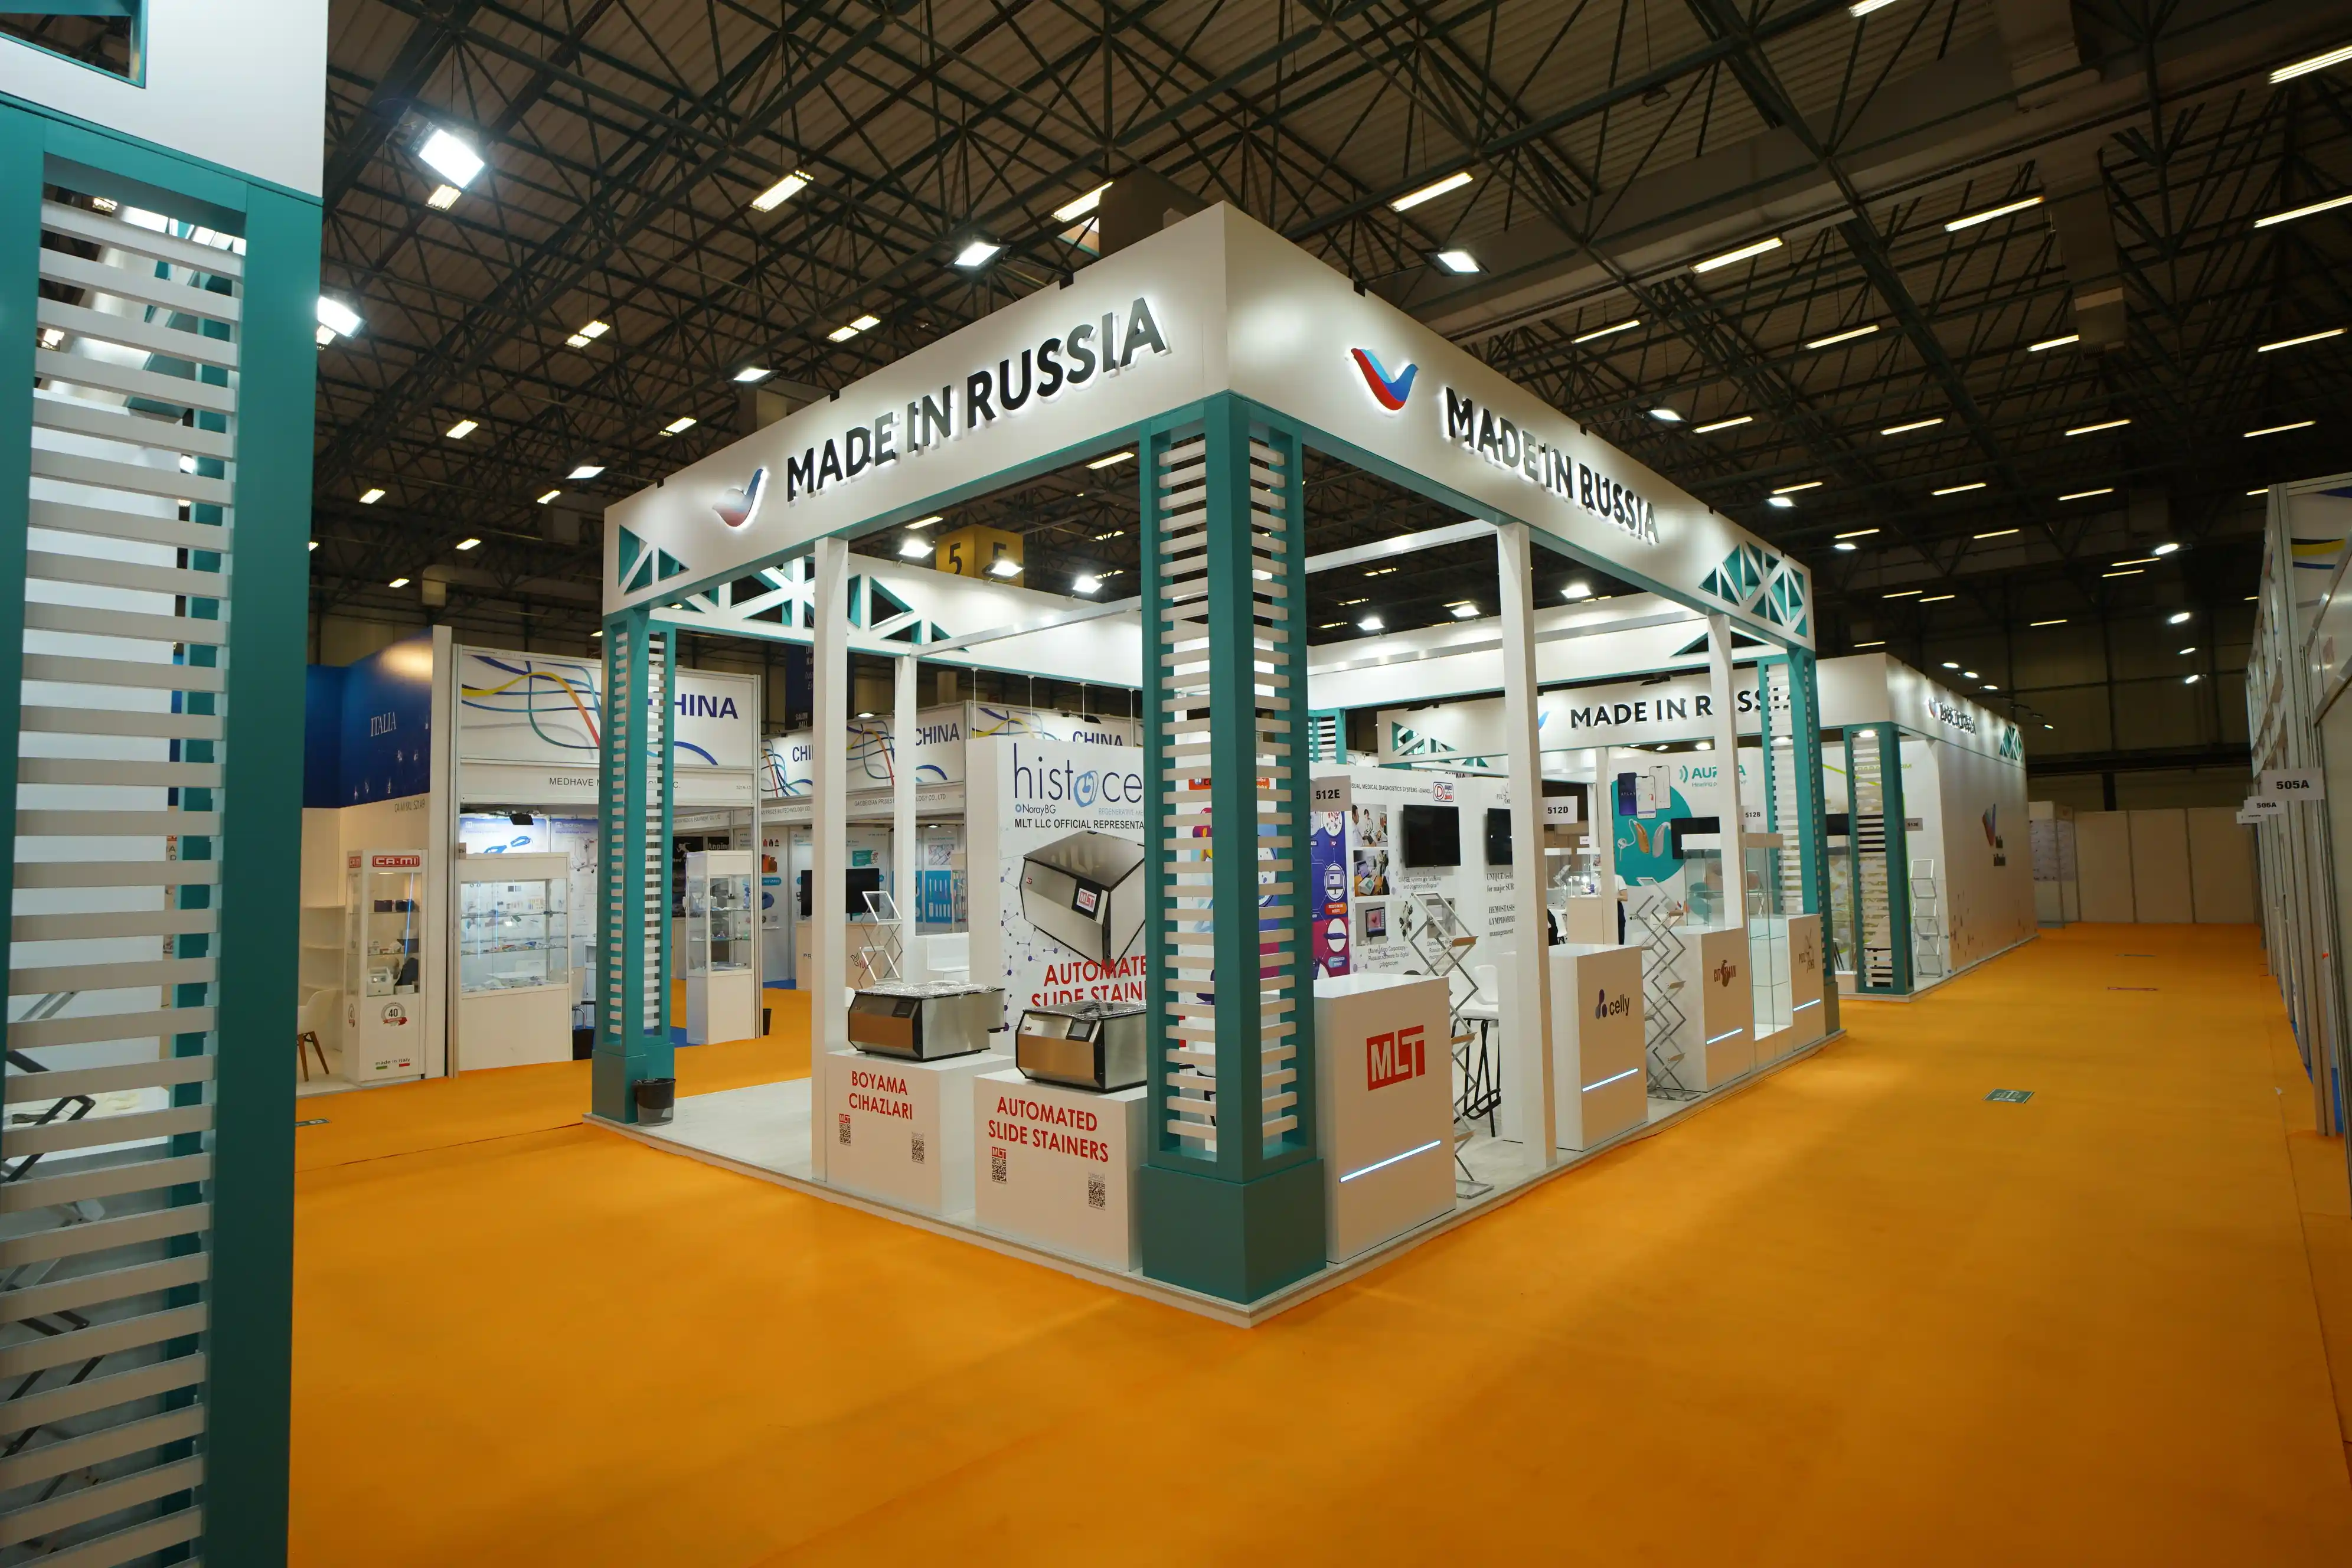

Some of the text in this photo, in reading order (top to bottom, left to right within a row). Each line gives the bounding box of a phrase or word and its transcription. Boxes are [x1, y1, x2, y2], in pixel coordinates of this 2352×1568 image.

[787, 297, 1165, 502] MADE IN RUSSIA
[1446, 387, 1660, 544] MADE IN RUSSIA
[949, 542, 962, 575] 5
[648, 691, 739, 720] HINA
[1570, 701, 1648, 729] MADE
[1657, 697, 1687, 720] IN
[371, 711, 397, 737] ITALIA
[916, 723, 960, 746] CHINA
[549, 778, 594, 786] MEDHAVE
[2276, 780, 2309, 789] 505A
[1315, 789, 1340, 800] 512E
[1023, 803, 1056, 816] NorayBG
[1547, 805, 1568, 814] 512D
[1015, 819, 1144, 829] MLT LLC OFFICIAL REPRESENTA
[1487, 873, 1504, 881] UNIQUE
[1494, 884, 1505, 893] major
[1079, 890, 1096, 908] MLT
[1044, 955, 1146, 986] AUTOMATE
[388, 1008, 398, 1017] 40
[1609, 994, 1630, 1017] celly
[1368, 1026, 1425, 1089] MLT
[852, 1070, 907, 1095] BOYAMA
[849, 1093, 912, 1120] CIHAZLARI
[997, 1096, 1097, 1131] AUTOMATED
[839, 1113, 850, 1124] MLT
[988, 1119, 1109, 1162] SLIDE STAINERS
[991, 1146, 1006, 1159] MLT
